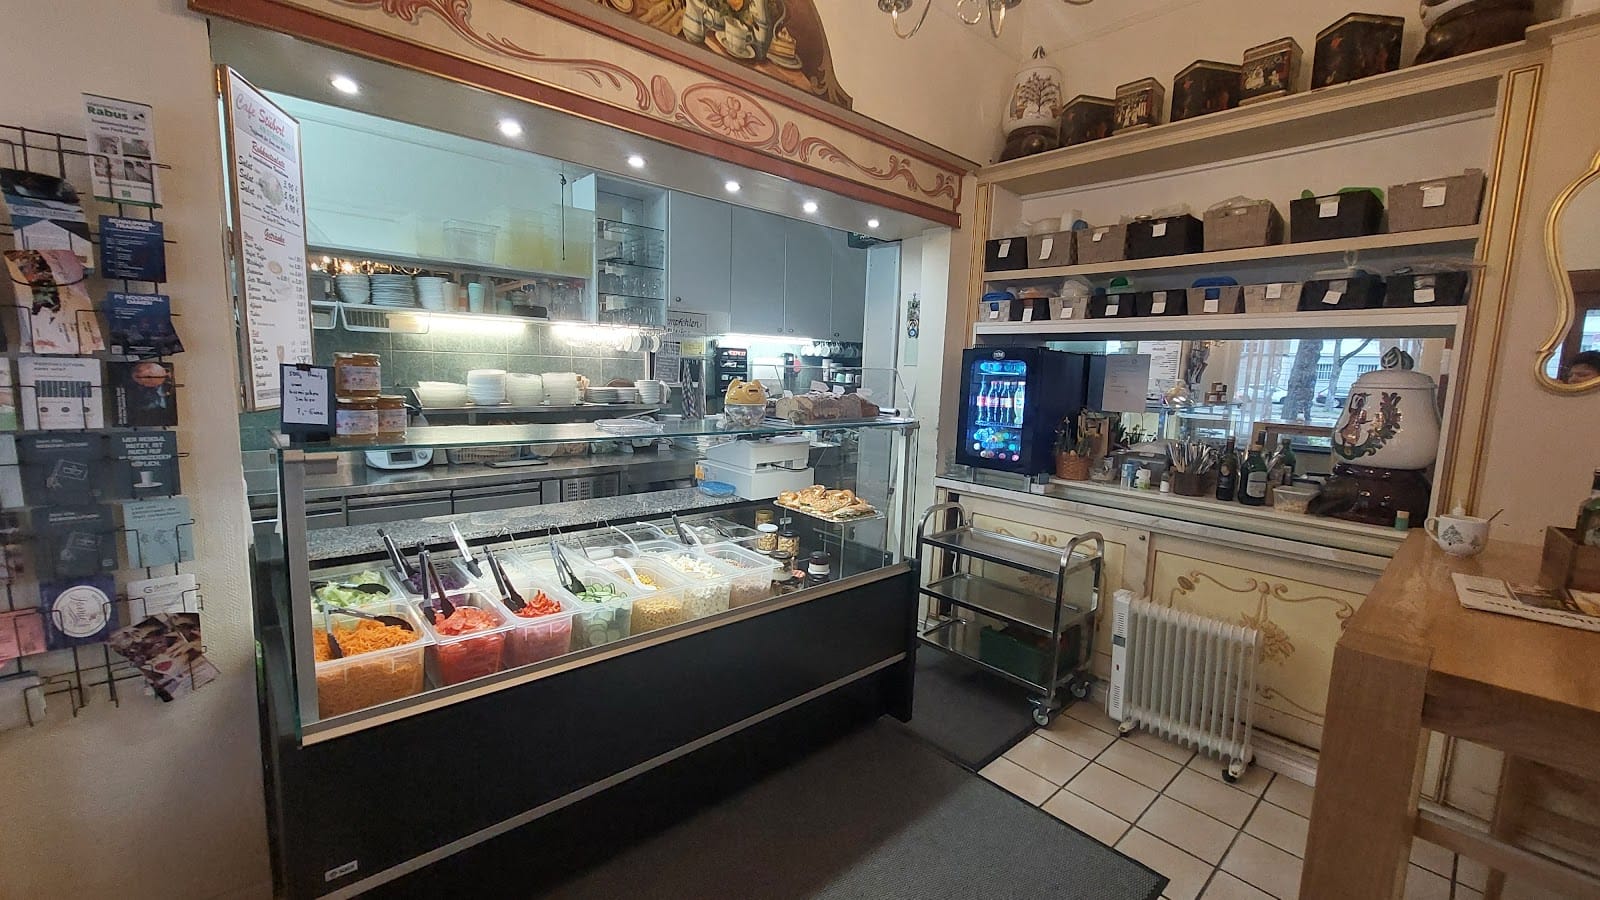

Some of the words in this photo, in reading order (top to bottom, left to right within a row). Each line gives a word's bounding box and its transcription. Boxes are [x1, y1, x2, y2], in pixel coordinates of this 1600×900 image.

[87, 106, 128, 120] Rabus
[238, 155, 253, 170] Salat
[239, 168, 254, 183] Salat
[240, 181, 255, 195] Salat
